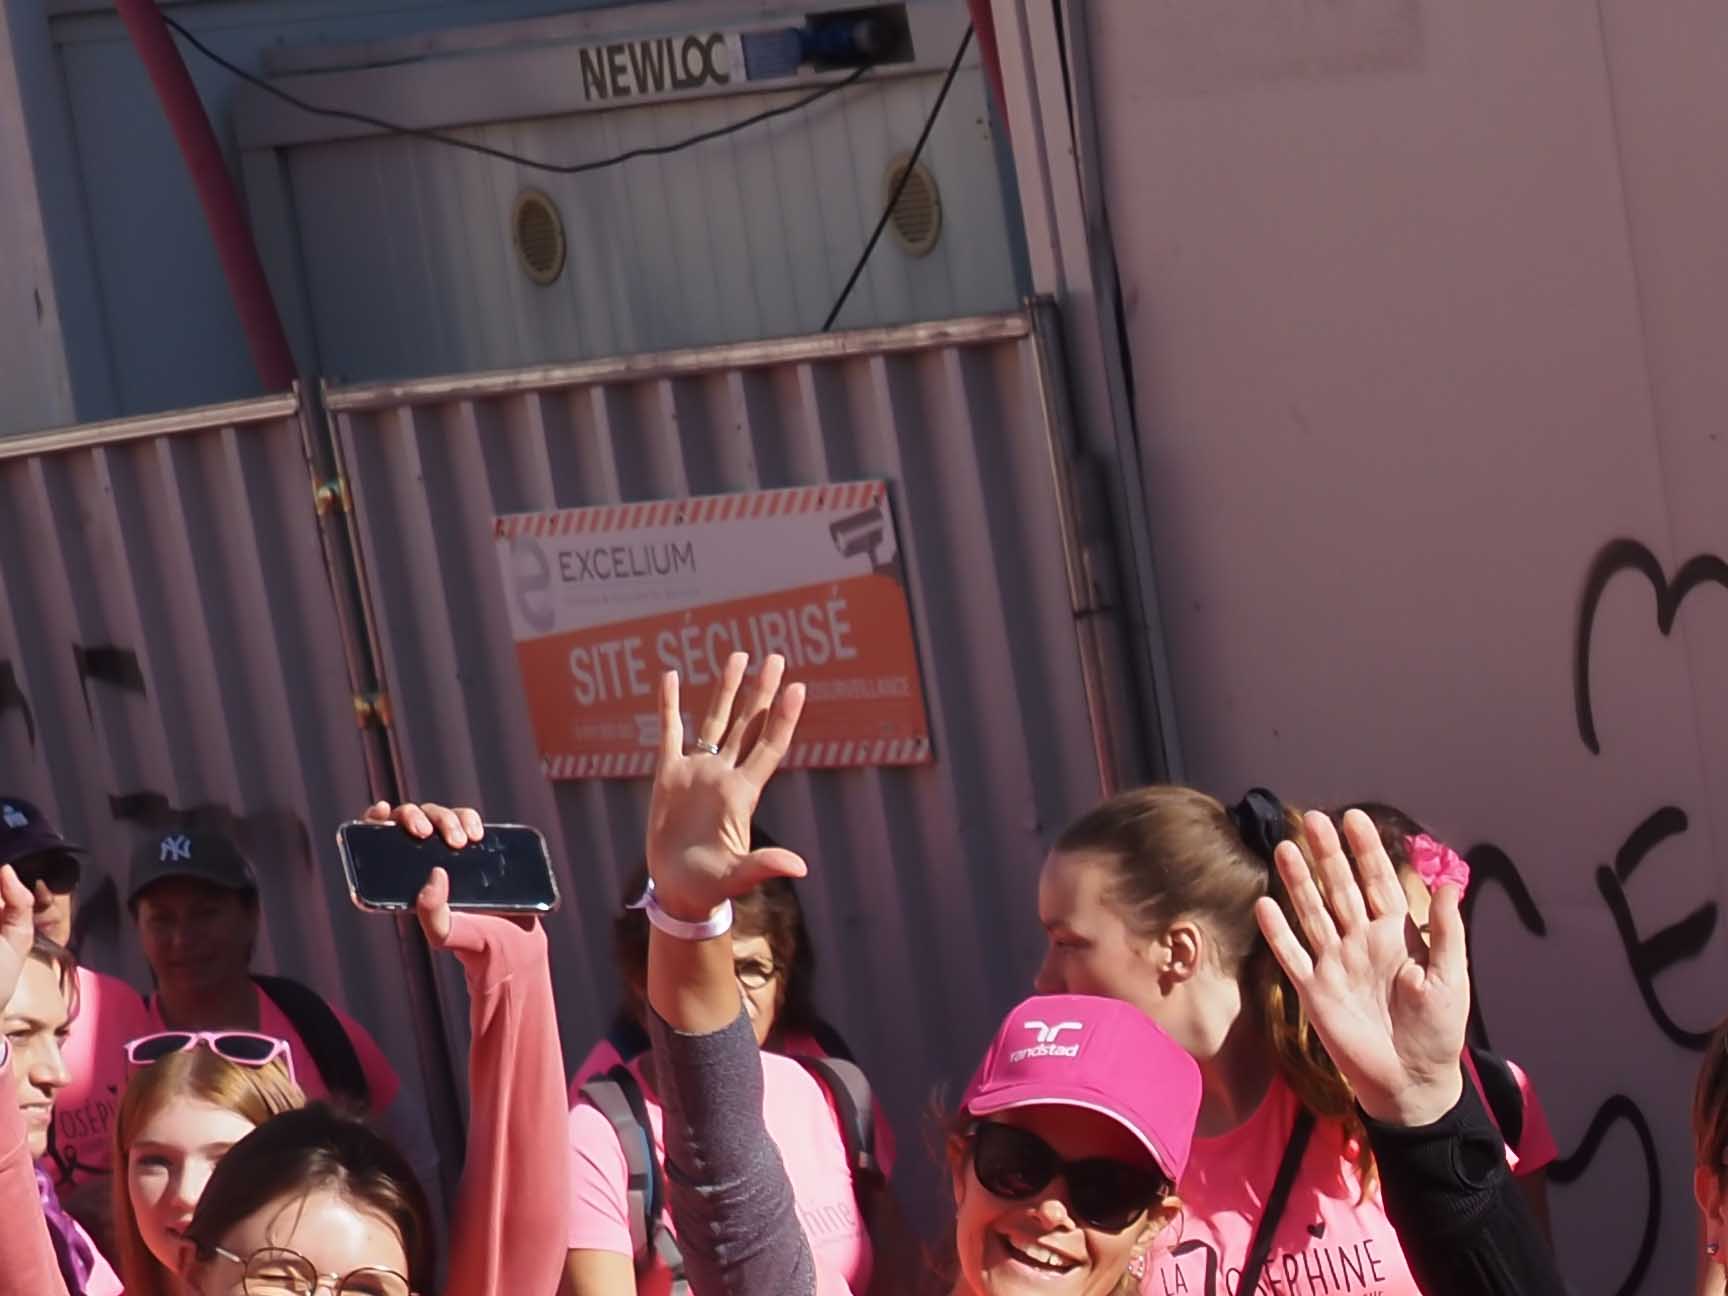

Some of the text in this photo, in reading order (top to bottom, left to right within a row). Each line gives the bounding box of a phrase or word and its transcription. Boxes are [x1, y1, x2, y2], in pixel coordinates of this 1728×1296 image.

[579, 32, 731, 101] NEWLOC
[558, 541, 697, 583] EXCELIUM
[568, 635, 652, 707] SITE
[1009, 1042, 1080, 1063] randstad
[1160, 1263, 1189, 1296] LA
